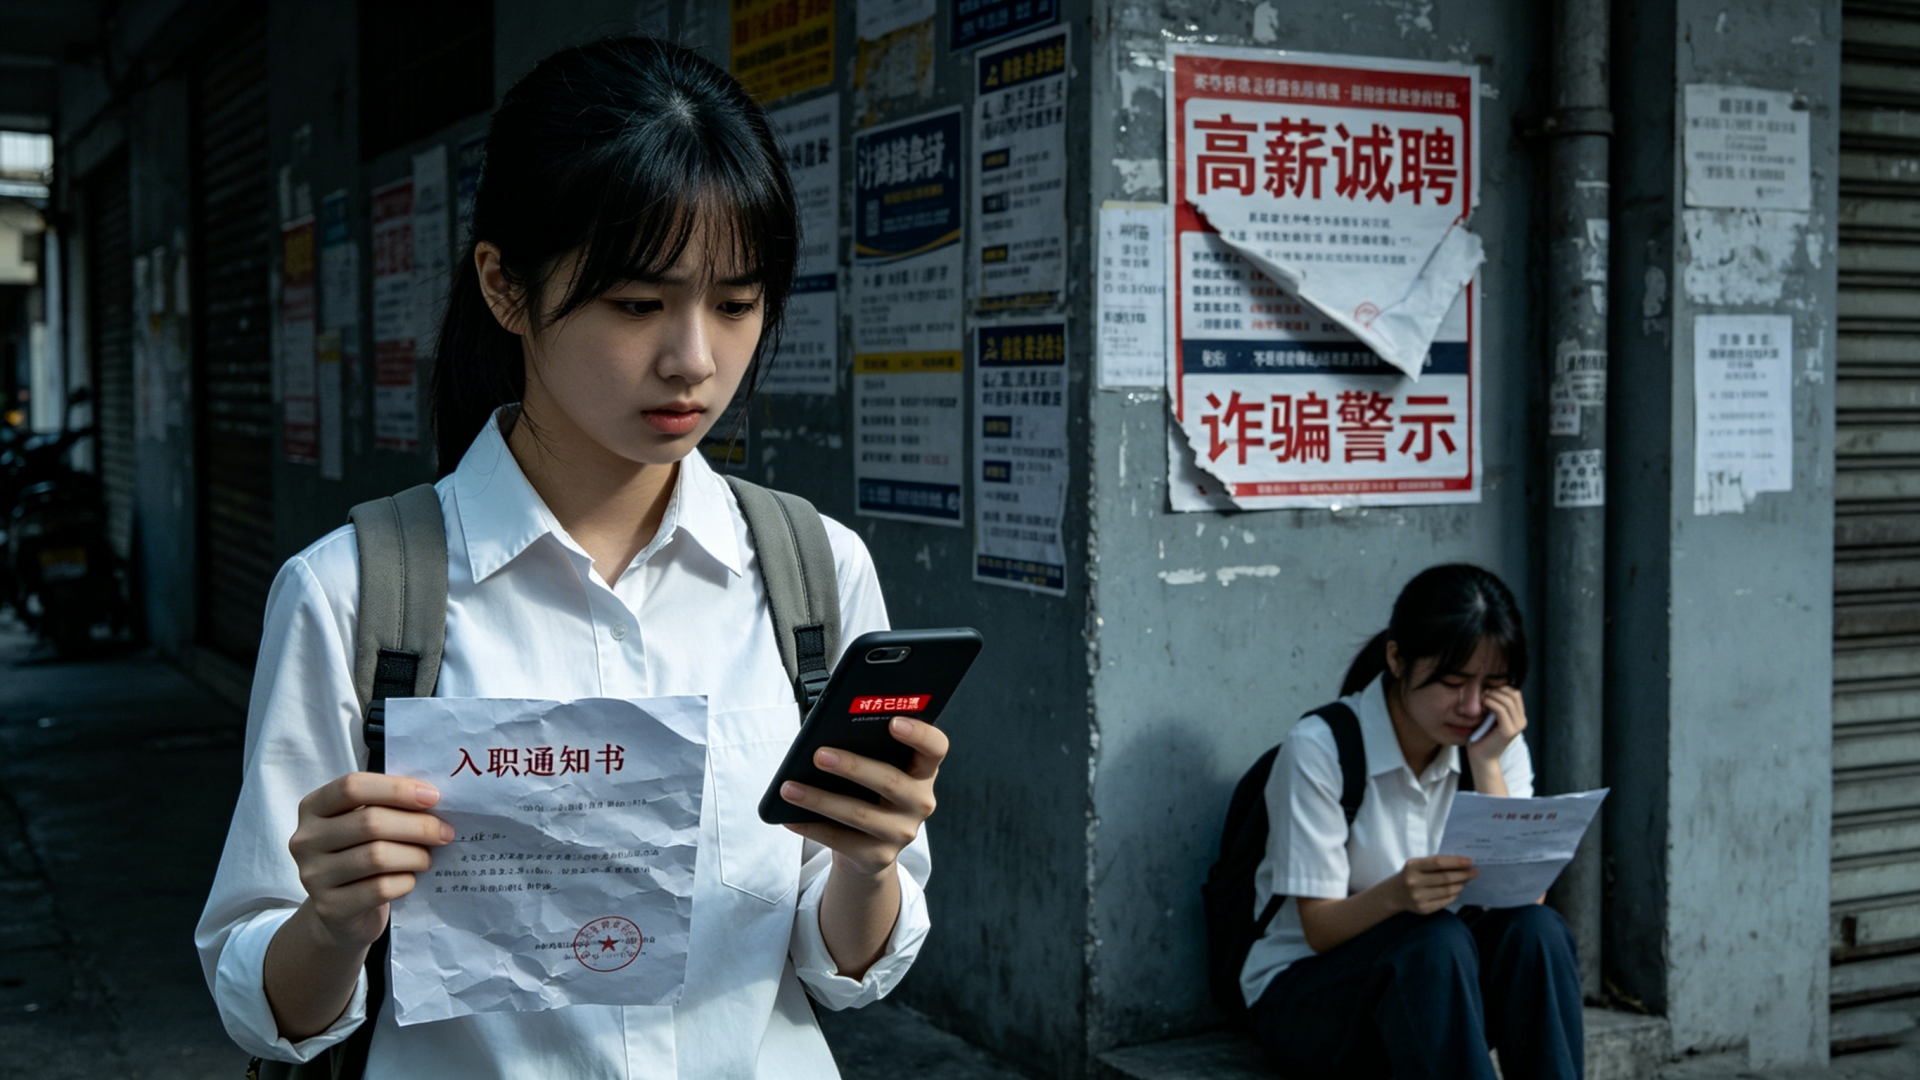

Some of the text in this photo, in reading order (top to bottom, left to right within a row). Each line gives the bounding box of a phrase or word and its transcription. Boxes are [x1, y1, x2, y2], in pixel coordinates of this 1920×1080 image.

[1193, 114, 1458, 205] 高薪诚聘
[1201, 391, 1456, 465] 诈骗警示
[450, 743, 626, 777] 入职通知书
